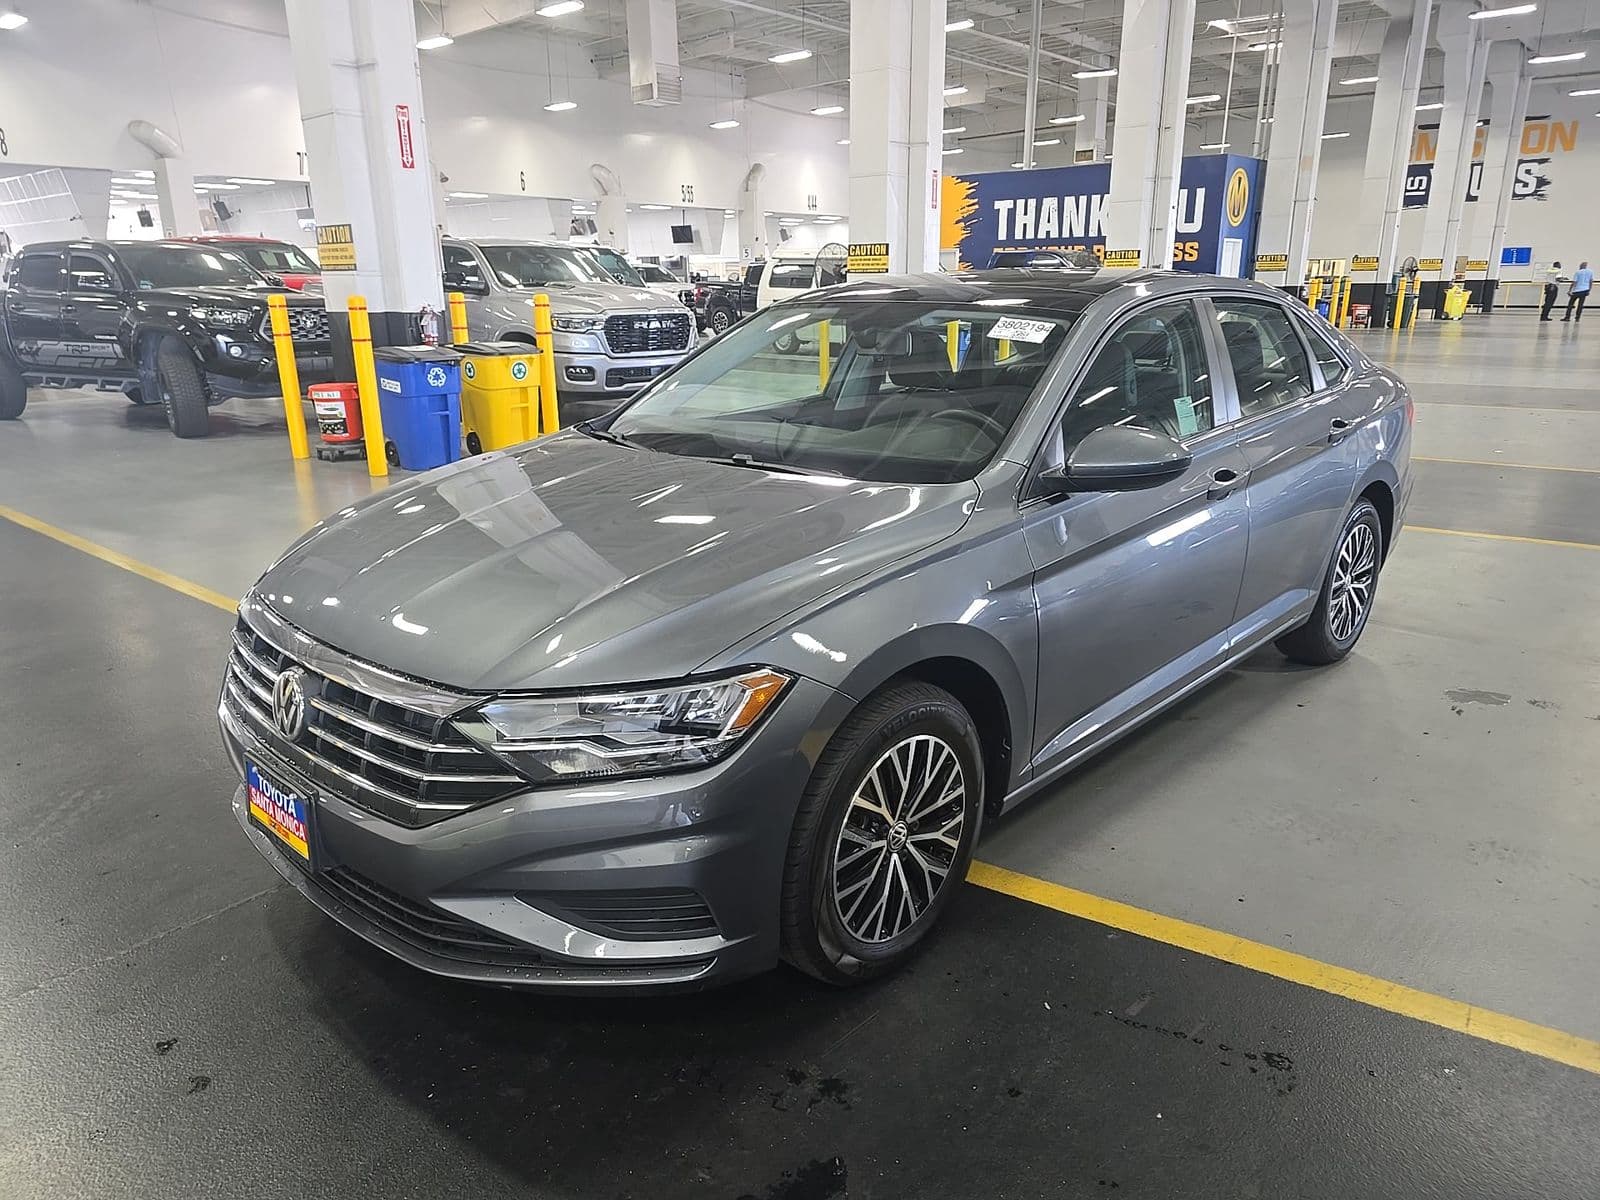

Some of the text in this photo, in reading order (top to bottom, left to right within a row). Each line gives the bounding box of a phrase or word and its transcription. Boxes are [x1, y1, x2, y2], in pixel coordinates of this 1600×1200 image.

[520, 171, 526, 192] 6
[849, 244, 887, 256] CAUTION
[1106, 250, 1139, 260] CAUTION
[632, 320, 676, 329] RAM
[64, 344, 90, 354] TRD
[257, 774, 297, 818] TOYOTA
[251, 787, 275, 818] SANTA
[275, 806, 306, 841] MONICA
